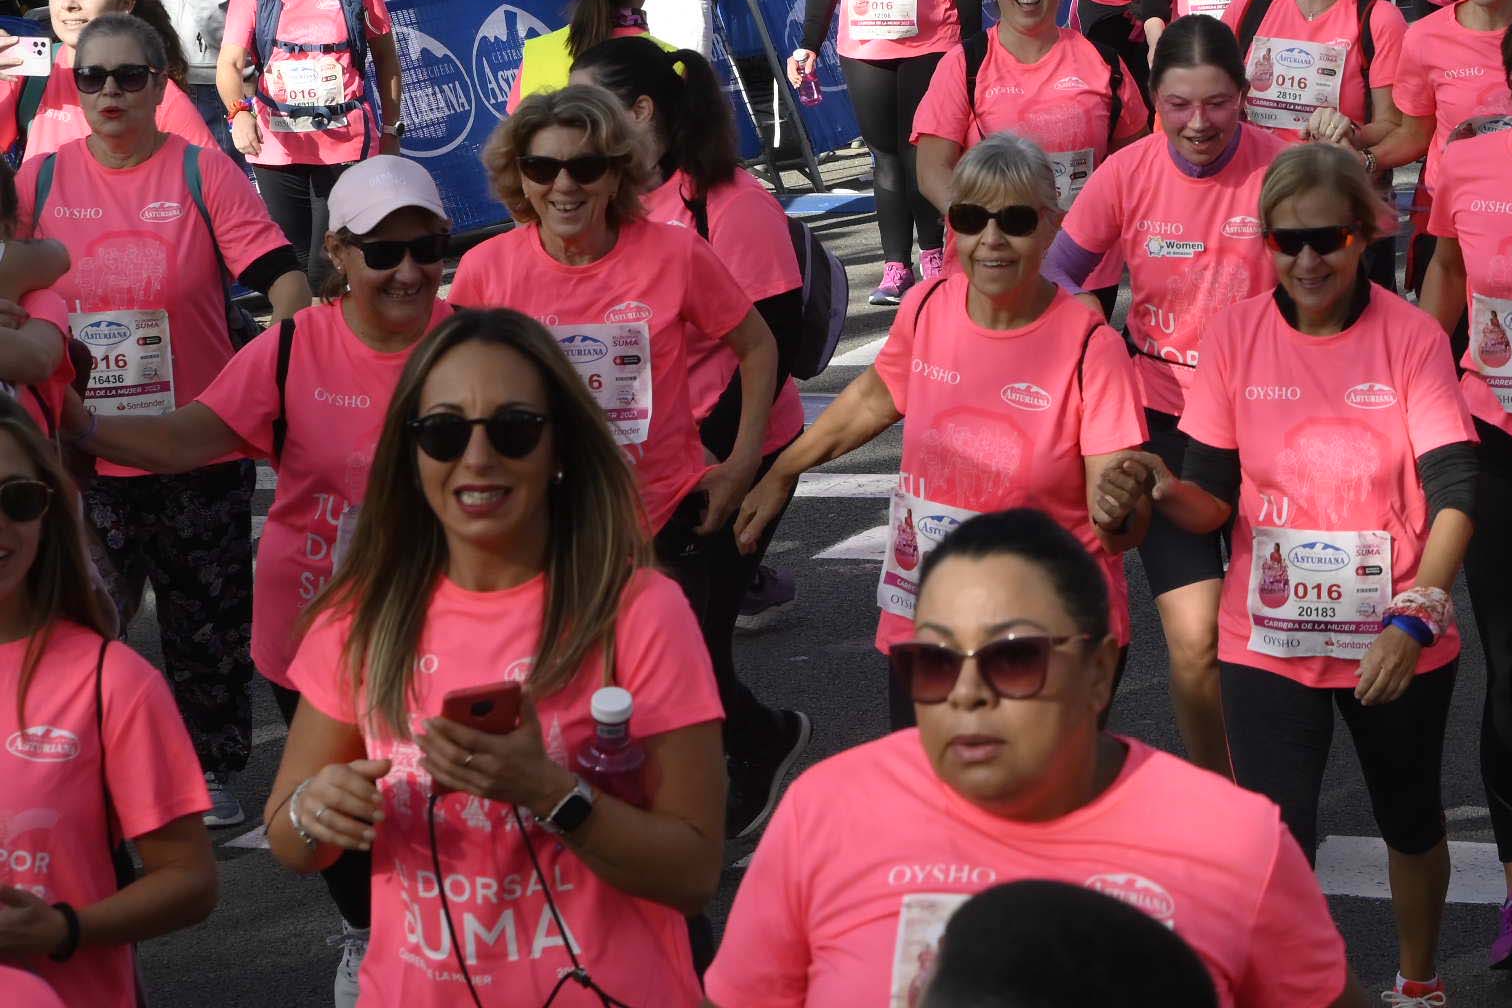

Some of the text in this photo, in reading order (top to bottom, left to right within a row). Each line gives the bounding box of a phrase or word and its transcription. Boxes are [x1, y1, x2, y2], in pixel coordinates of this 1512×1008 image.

[871, 1, 893, 10] 016
[1444, 66, 1485, 80] OYSHO
[1275, 74, 1308, 90] 016
[1276, 91, 1302, 101] 28191
[54, 206, 103, 220] OYSHO
[142, 208, 183, 221] ASTURIANA
[1137, 220, 1183, 235] OYSHO
[1165, 240, 1203, 251] Women
[609, 311, 650, 322] ASTURIANA
[1144, 304, 1175, 334] TU
[135, 322, 160, 330] SUMA
[83, 330, 128, 340] ASTURIANA
[912, 358, 961, 385] OYSHO
[93, 374, 124, 385] 16436
[118, 387, 142, 395] MUJER
[314, 387, 370, 408] OYSHO
[1003, 387, 1049, 408] ASTURIANA
[1245, 386, 1300, 401] OYSHO
[1348, 391, 1395, 404] ASTURIANA
[126, 400, 165, 410] Santander
[1259, 494, 1288, 527] TU
[1292, 552, 1346, 565] ASTURIANA
[1355, 548, 1381, 557] SUMA
[1294, 582, 1343, 601] 016
[1298, 606, 1336, 617] 20183
[1264, 619, 1299, 629] CARRERA
[1327, 623, 1356, 631] MUJER
[1263, 633, 1301, 648] OYSHO
[1335, 638, 1372, 649] Santand
[14, 737, 77, 753] ASTURIANA
[888, 863, 997, 887] OYSHO
[416, 864, 575, 905] DORSAL
